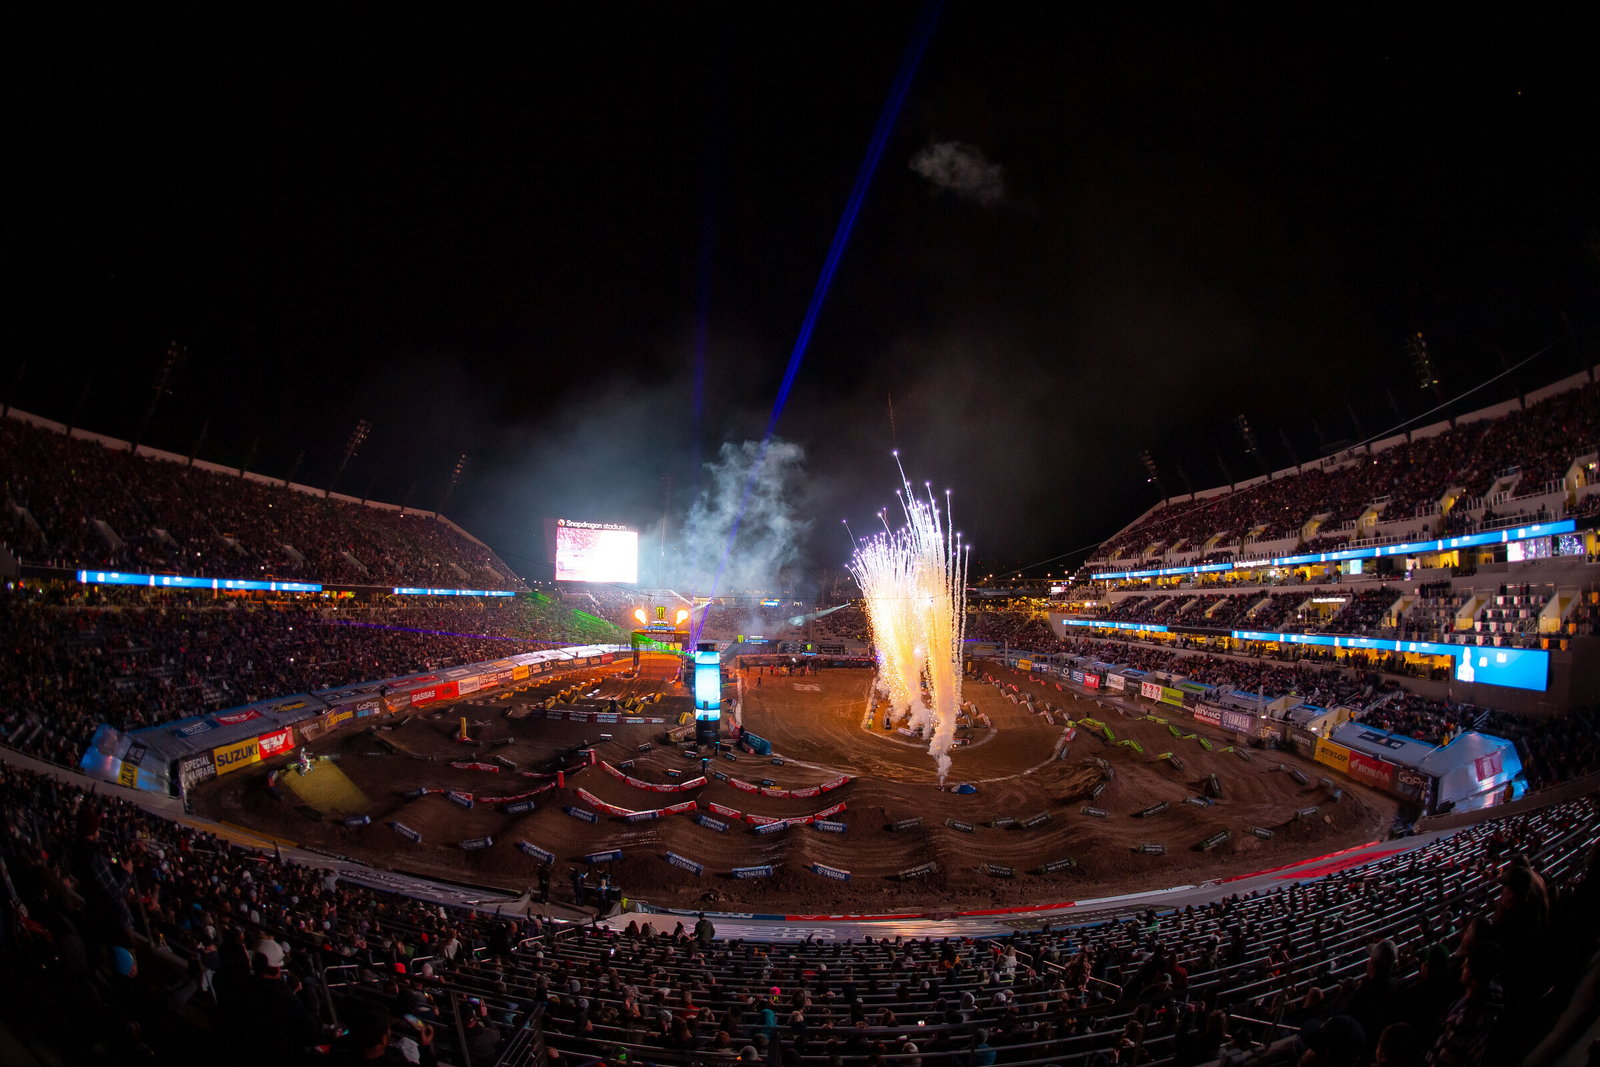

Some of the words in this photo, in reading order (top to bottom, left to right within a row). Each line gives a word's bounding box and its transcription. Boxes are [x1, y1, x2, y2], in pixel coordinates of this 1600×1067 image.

[566, 520, 602, 529] Snapdragon
[412, 690, 436, 702] GASGAS
[357, 701, 380, 711] GoPro
[1228, 713, 1250, 729] YAMAHA
[216, 744, 259, 767] SUZUKI
[1320, 746, 1348, 762] DUNLOP
[184, 756, 211, 771] SPECIAL
[185, 765, 216, 782] WARFARE
[1358, 763, 1390, 781] HONDA
